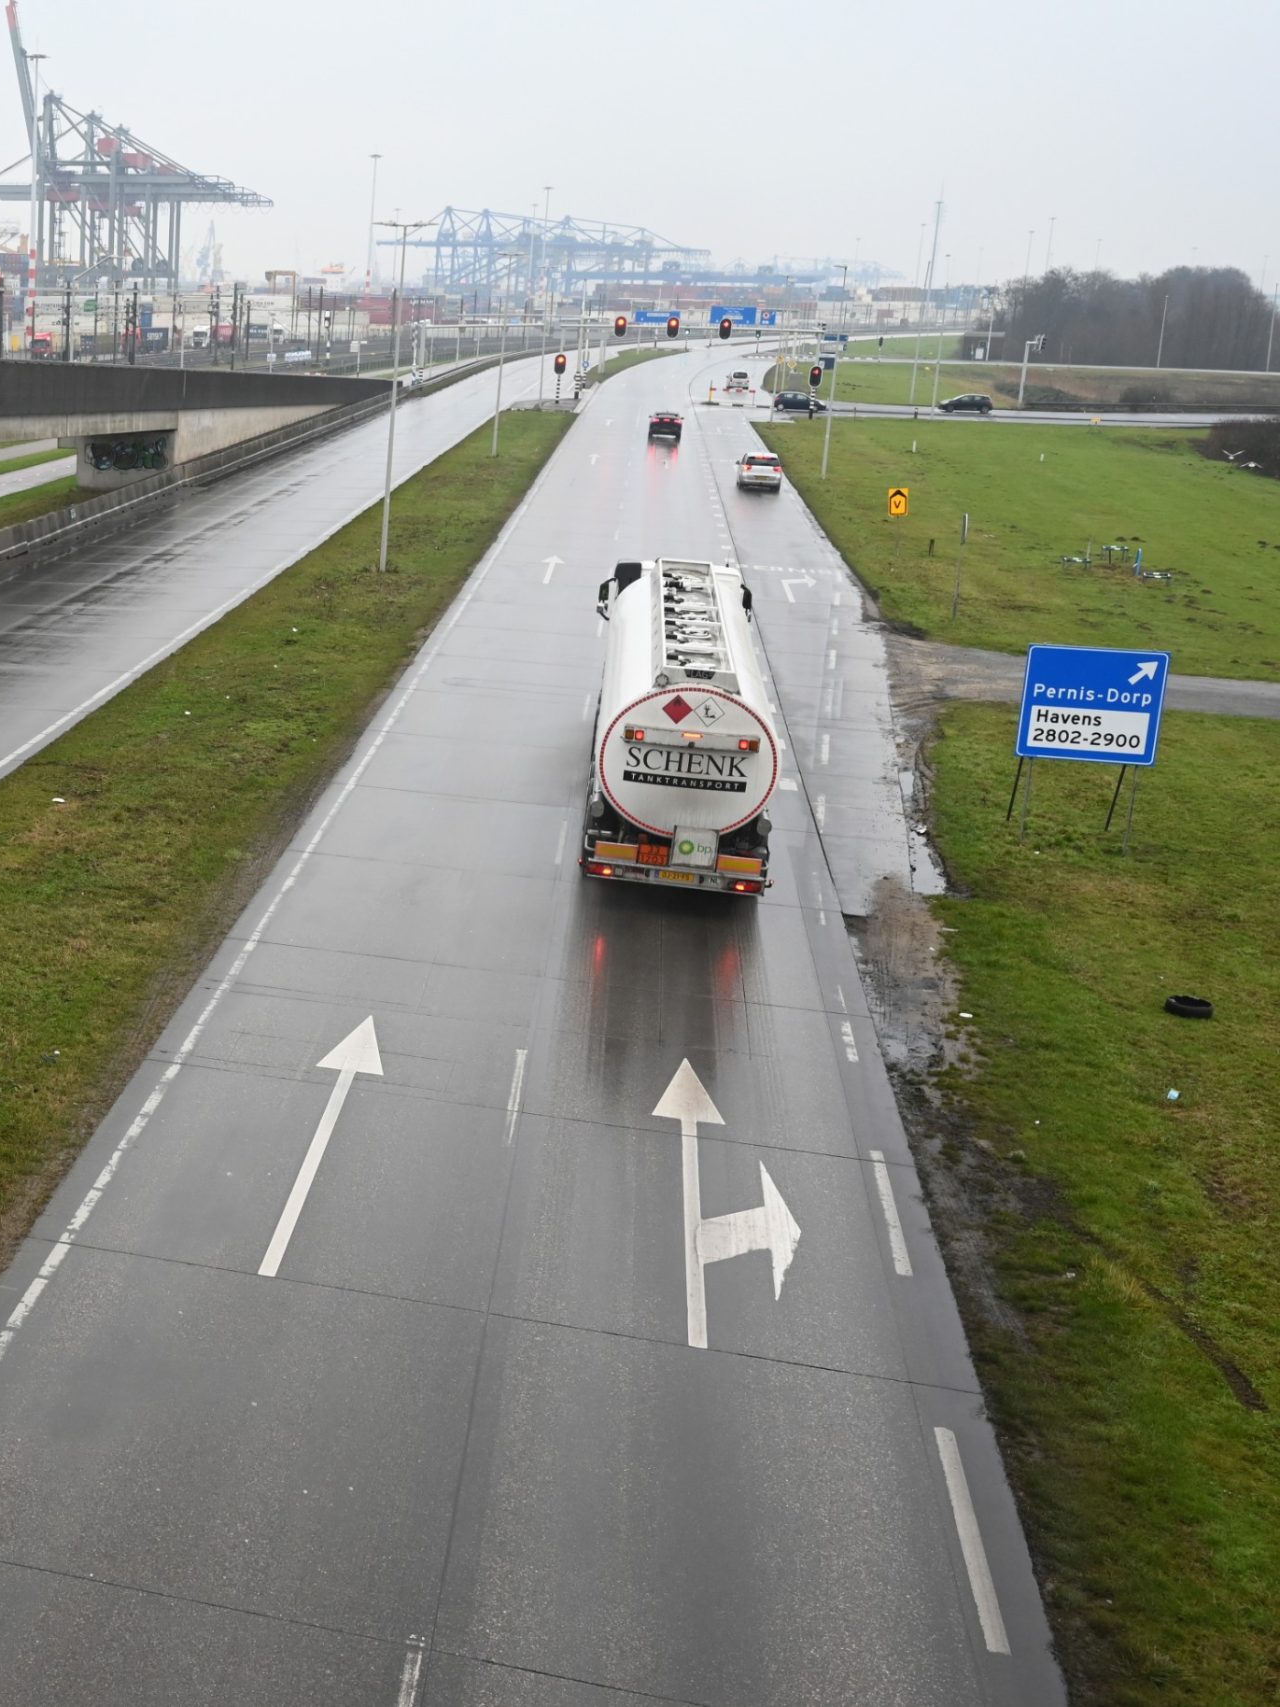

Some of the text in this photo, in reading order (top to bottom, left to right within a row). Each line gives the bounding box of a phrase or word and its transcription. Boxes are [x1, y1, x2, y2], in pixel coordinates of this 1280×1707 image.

[1033, 683, 1152, 708] Pernis-Dorp
[1036, 709, 1102, 726] Havens
[1032, 728, 1141, 749] 2802-2900
[626, 746, 748, 778] SCHENK
[631, 772, 740, 790] TANKTRANSPORT
[697, 843, 712, 855] bp
[640, 855, 665, 866] 1203
